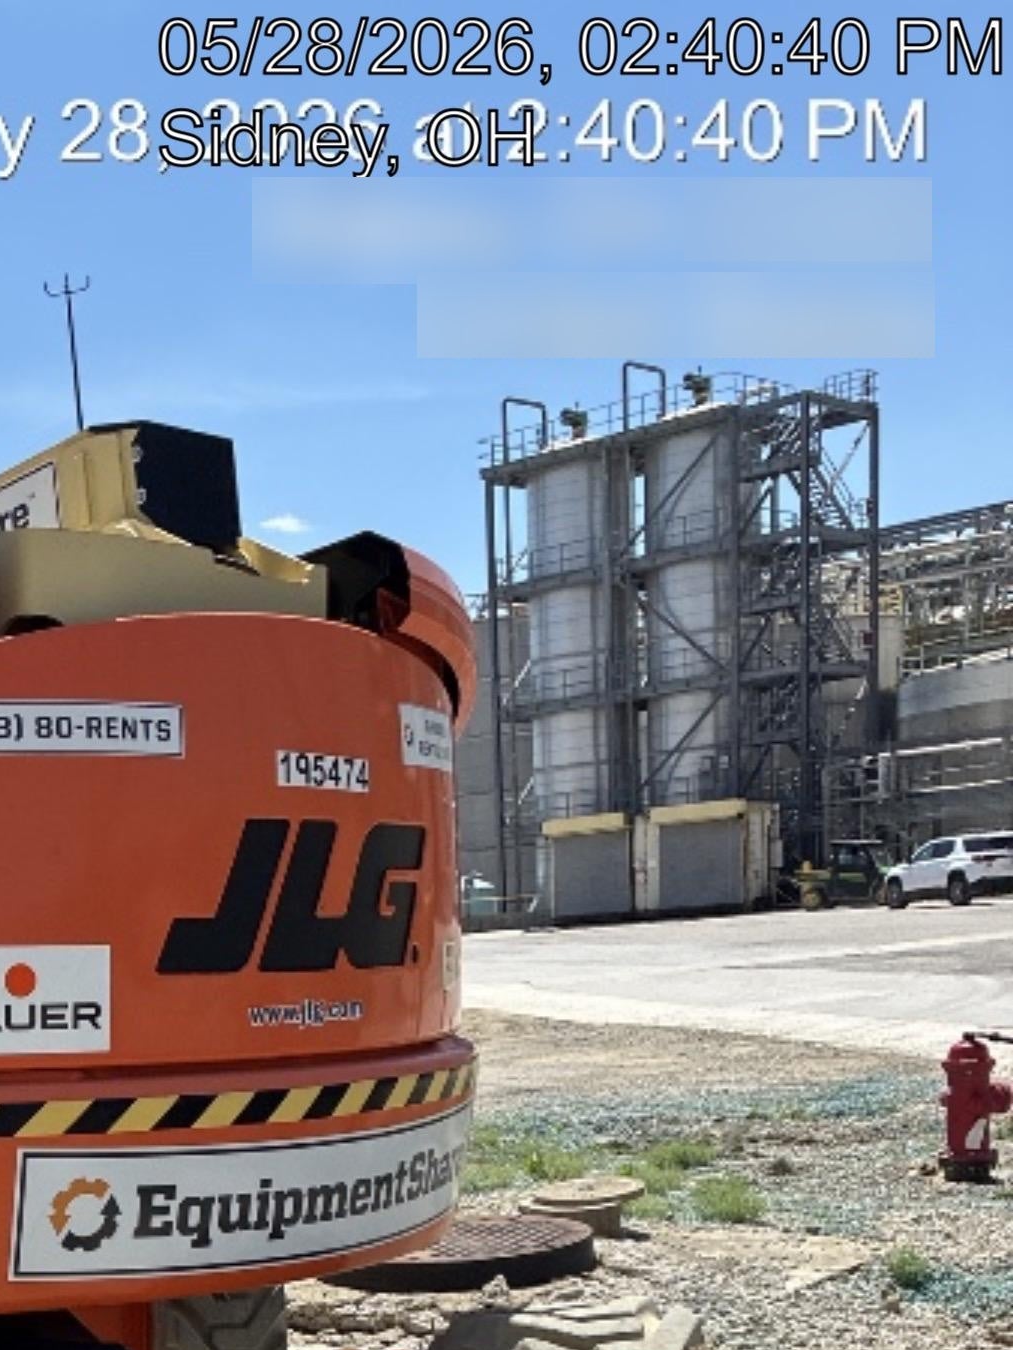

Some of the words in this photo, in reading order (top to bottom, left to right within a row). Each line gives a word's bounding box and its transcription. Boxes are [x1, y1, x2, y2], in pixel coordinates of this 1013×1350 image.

[33, 715, 173, 743] 80-RENTS
[278, 752, 369, 789] 195474
[155, 819, 426, 974] JLG
[133, 1143, 466, 1248] EquipmentShar
